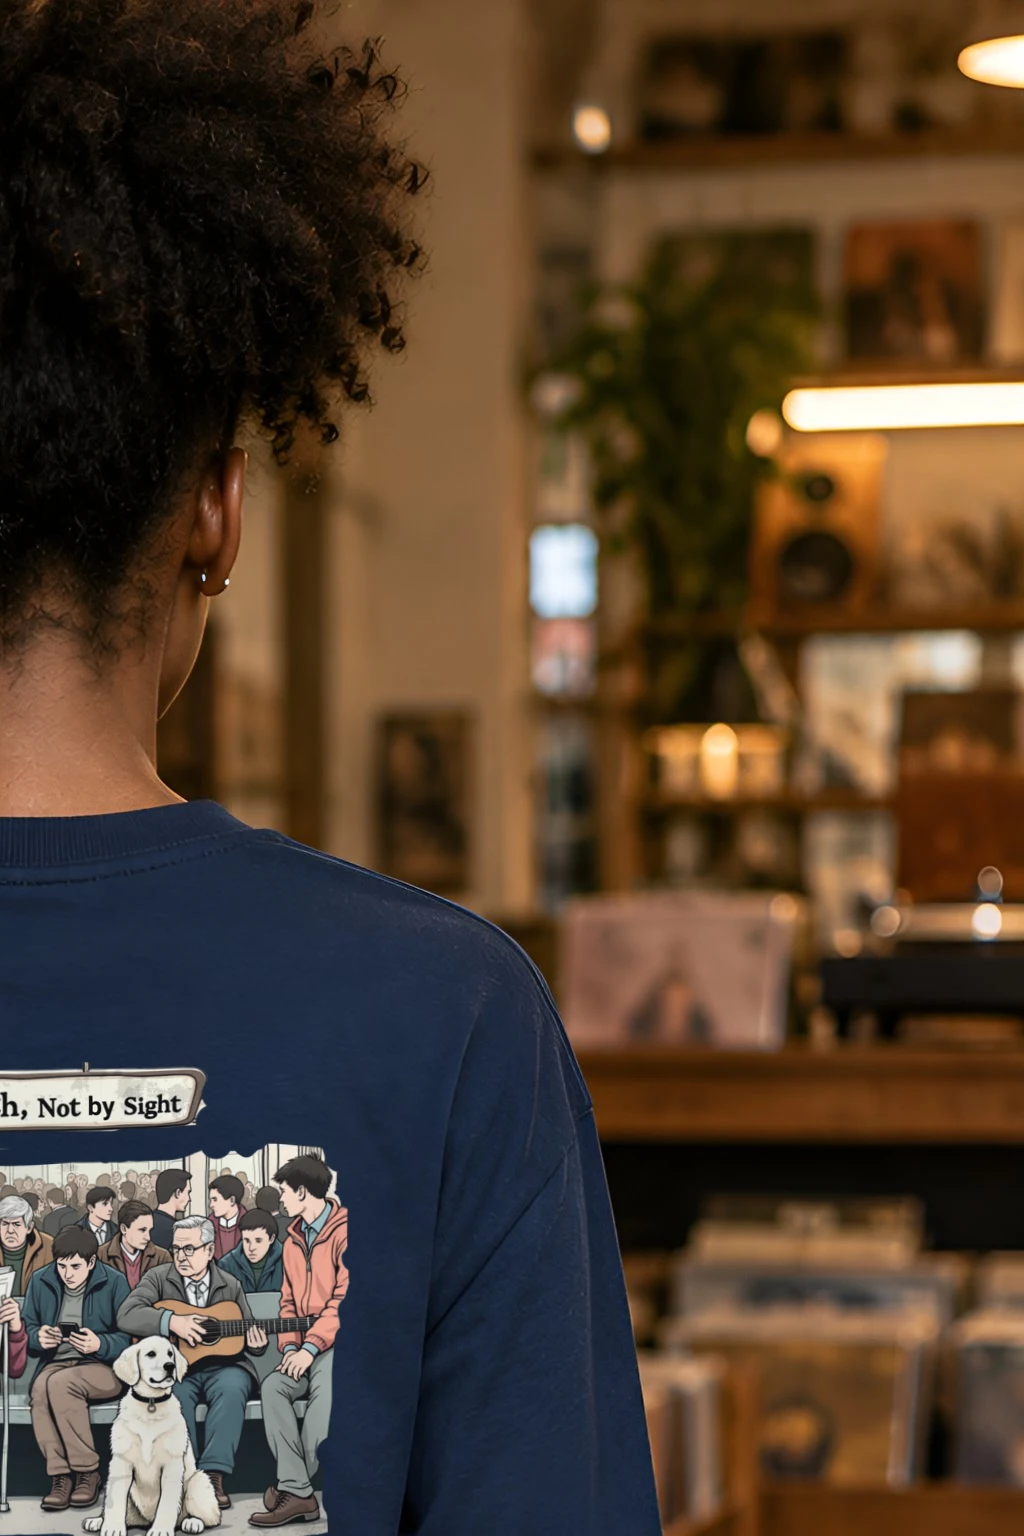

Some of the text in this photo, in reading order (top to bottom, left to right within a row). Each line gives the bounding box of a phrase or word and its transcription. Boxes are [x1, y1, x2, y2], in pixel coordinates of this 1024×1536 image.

[37, 1097, 81, 1118] Not
[88, 1096, 114, 1120] by
[123, 1094, 182, 1119] Sight
